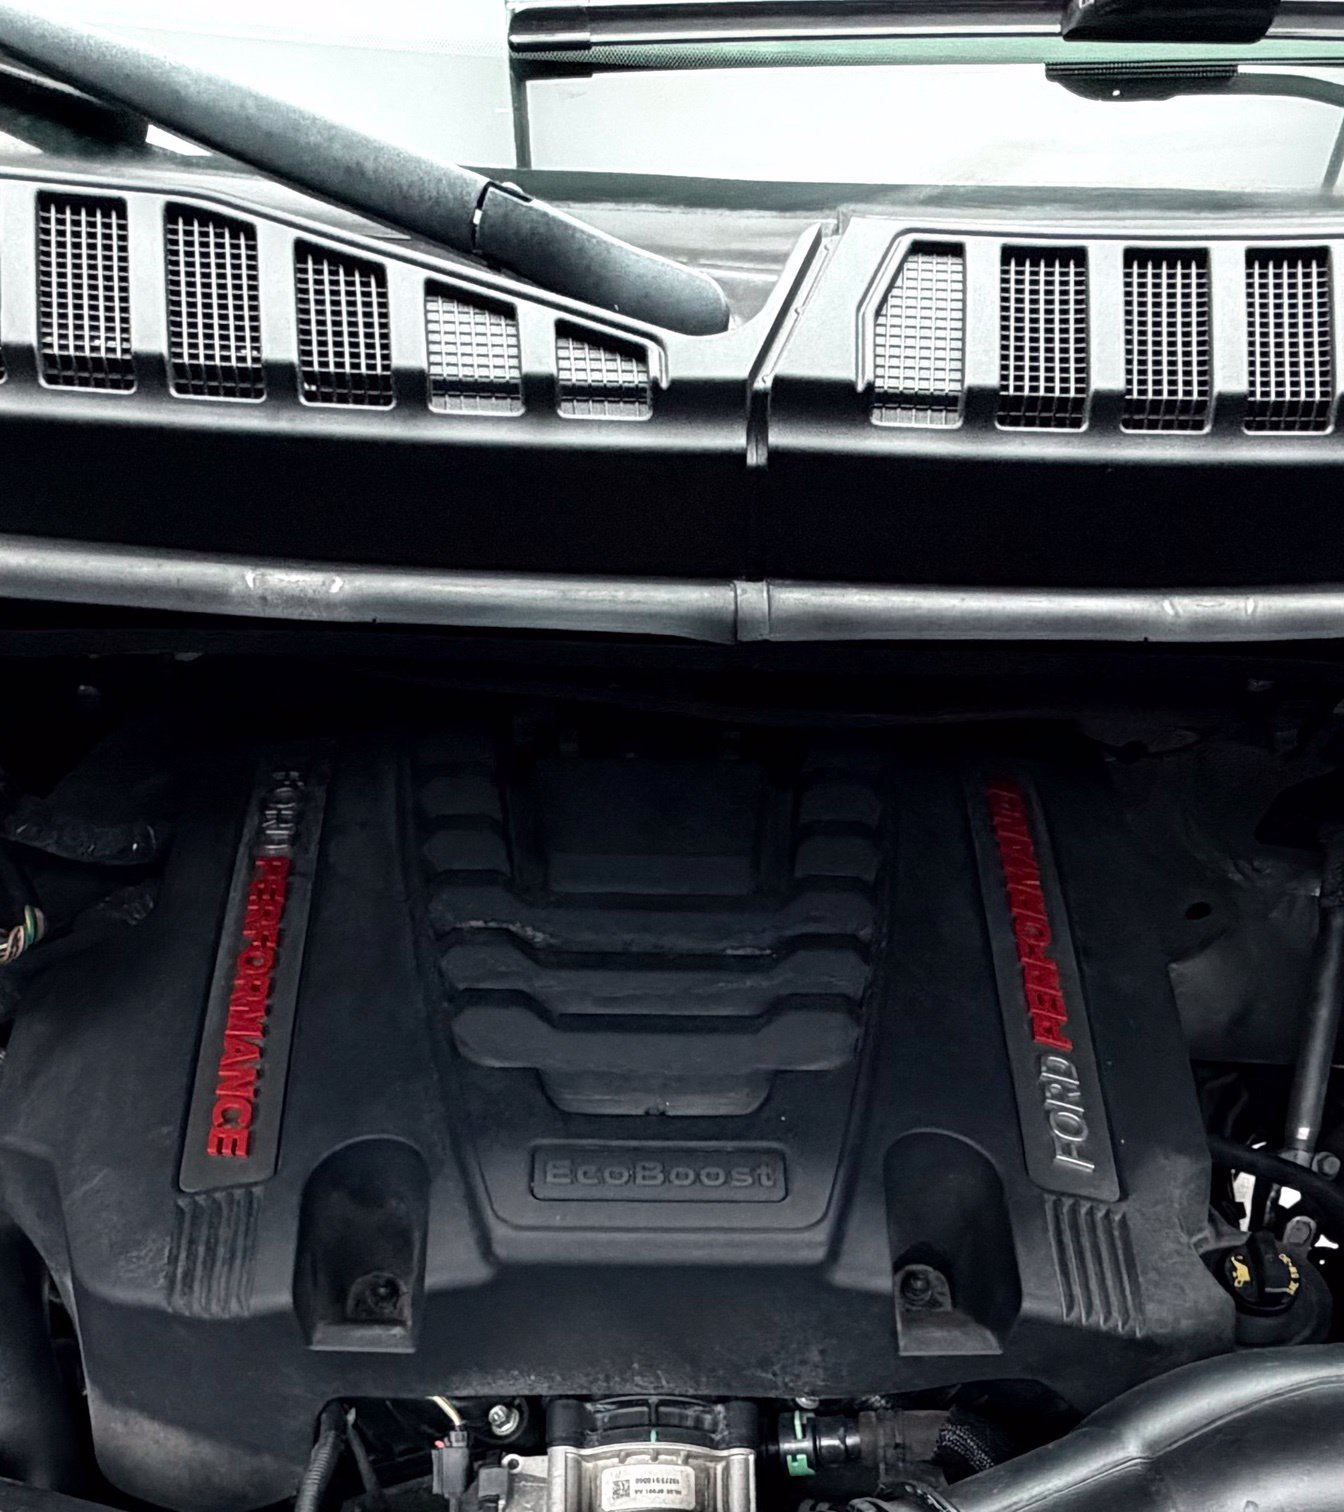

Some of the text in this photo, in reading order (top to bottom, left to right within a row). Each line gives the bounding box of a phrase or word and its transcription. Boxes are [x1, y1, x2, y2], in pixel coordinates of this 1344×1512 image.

[207, 857, 291, 1158] PERFORMANCE
[544, 1158, 778, 1188] EcoBoost
[1039, 1053, 1096, 1174] FORD
